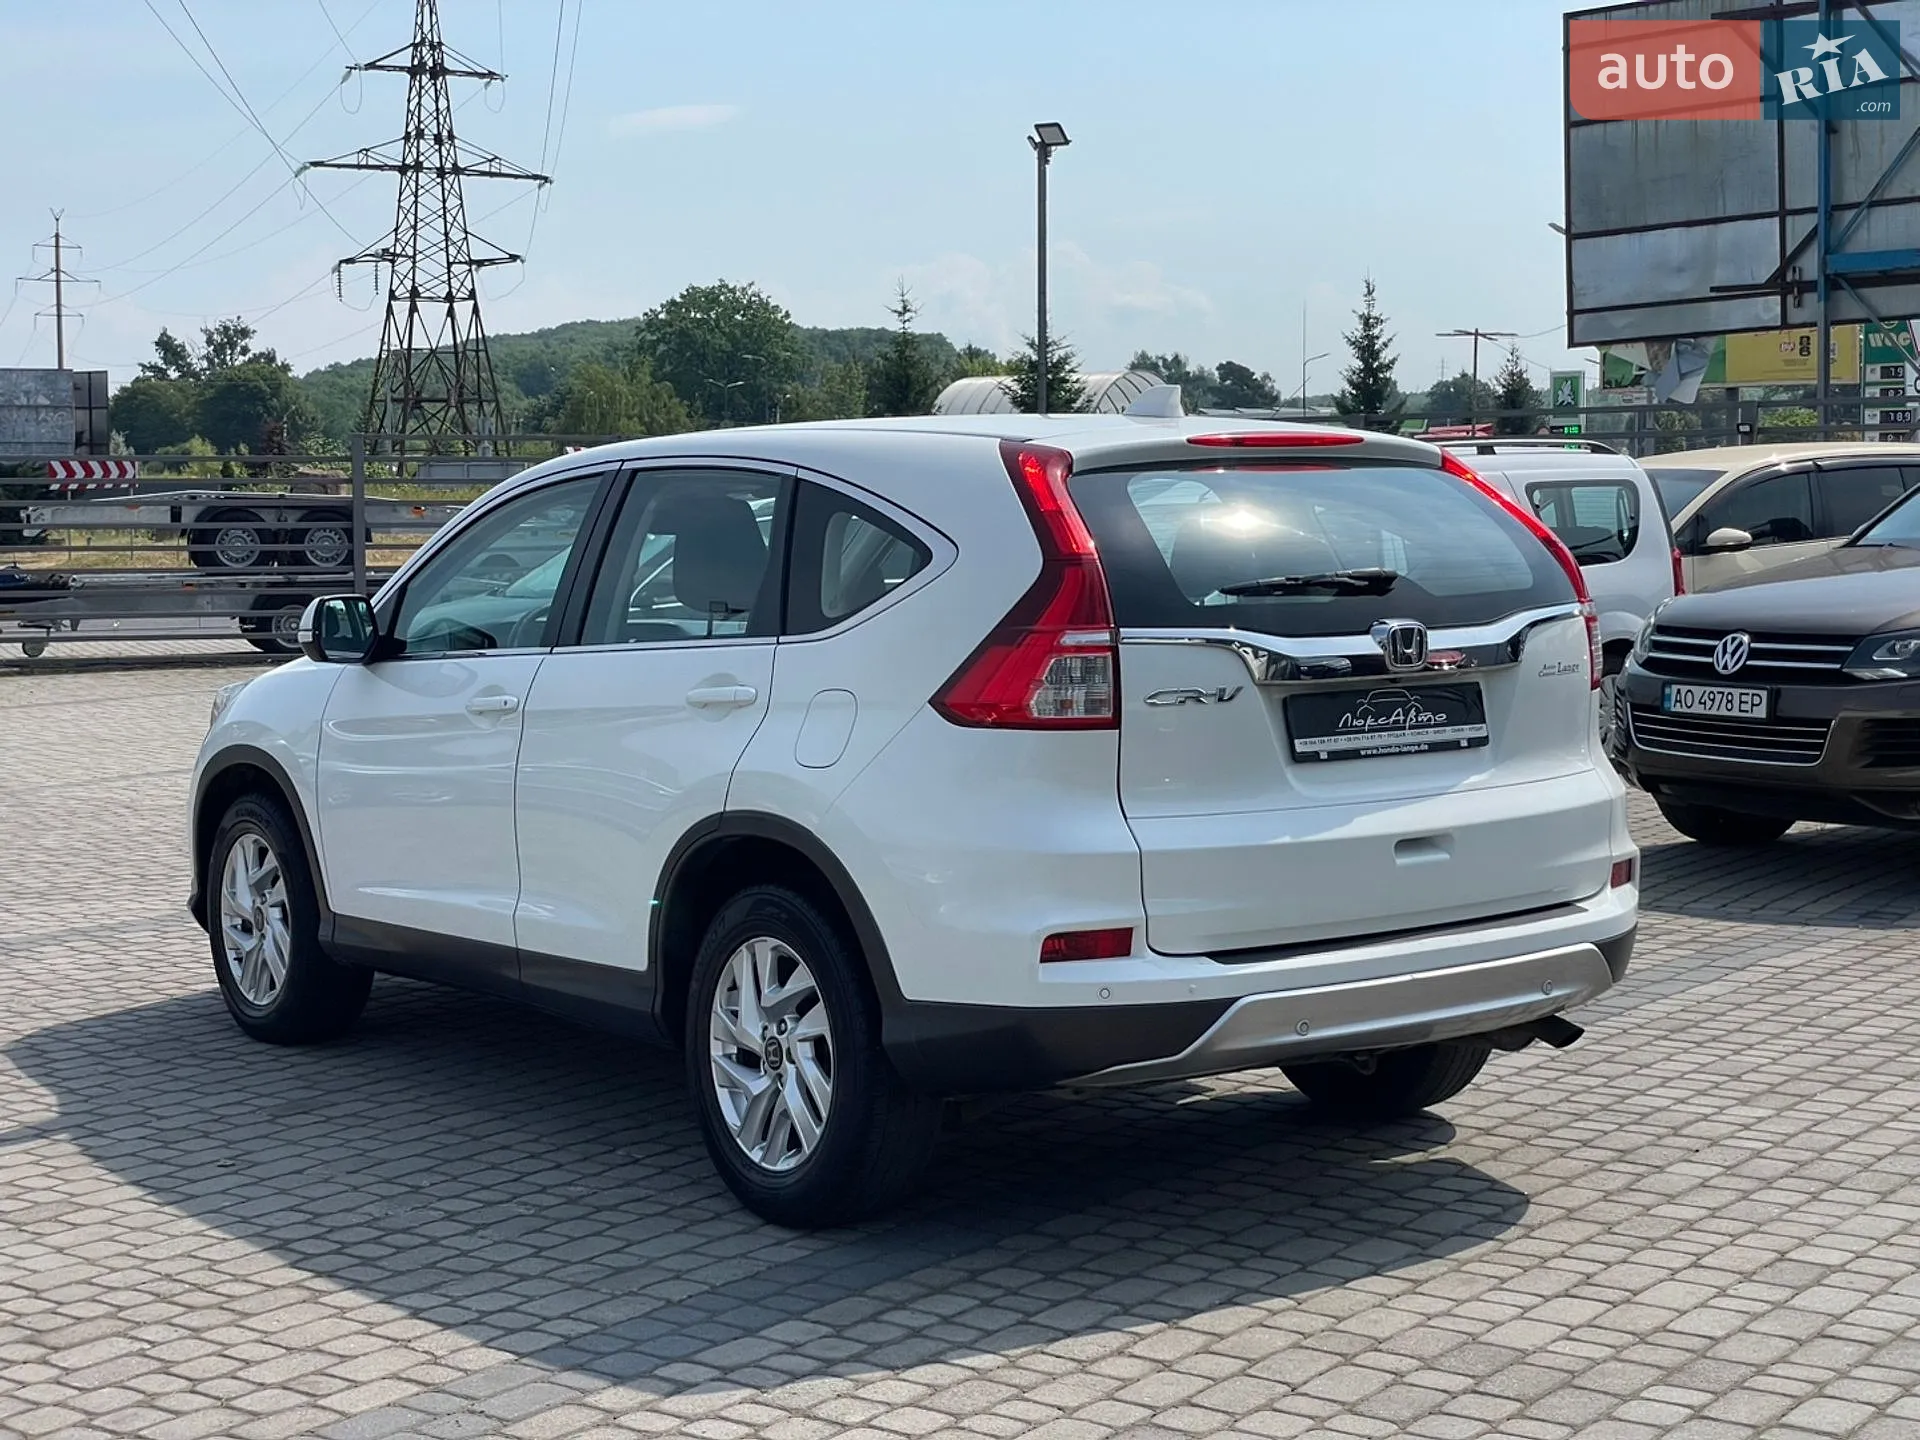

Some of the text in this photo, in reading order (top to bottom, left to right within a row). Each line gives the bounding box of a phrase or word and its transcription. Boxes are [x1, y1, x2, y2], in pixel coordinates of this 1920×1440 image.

[1144, 686, 1244, 706] CR-V
[1673, 688, 1763, 713] AO 4978 EP
